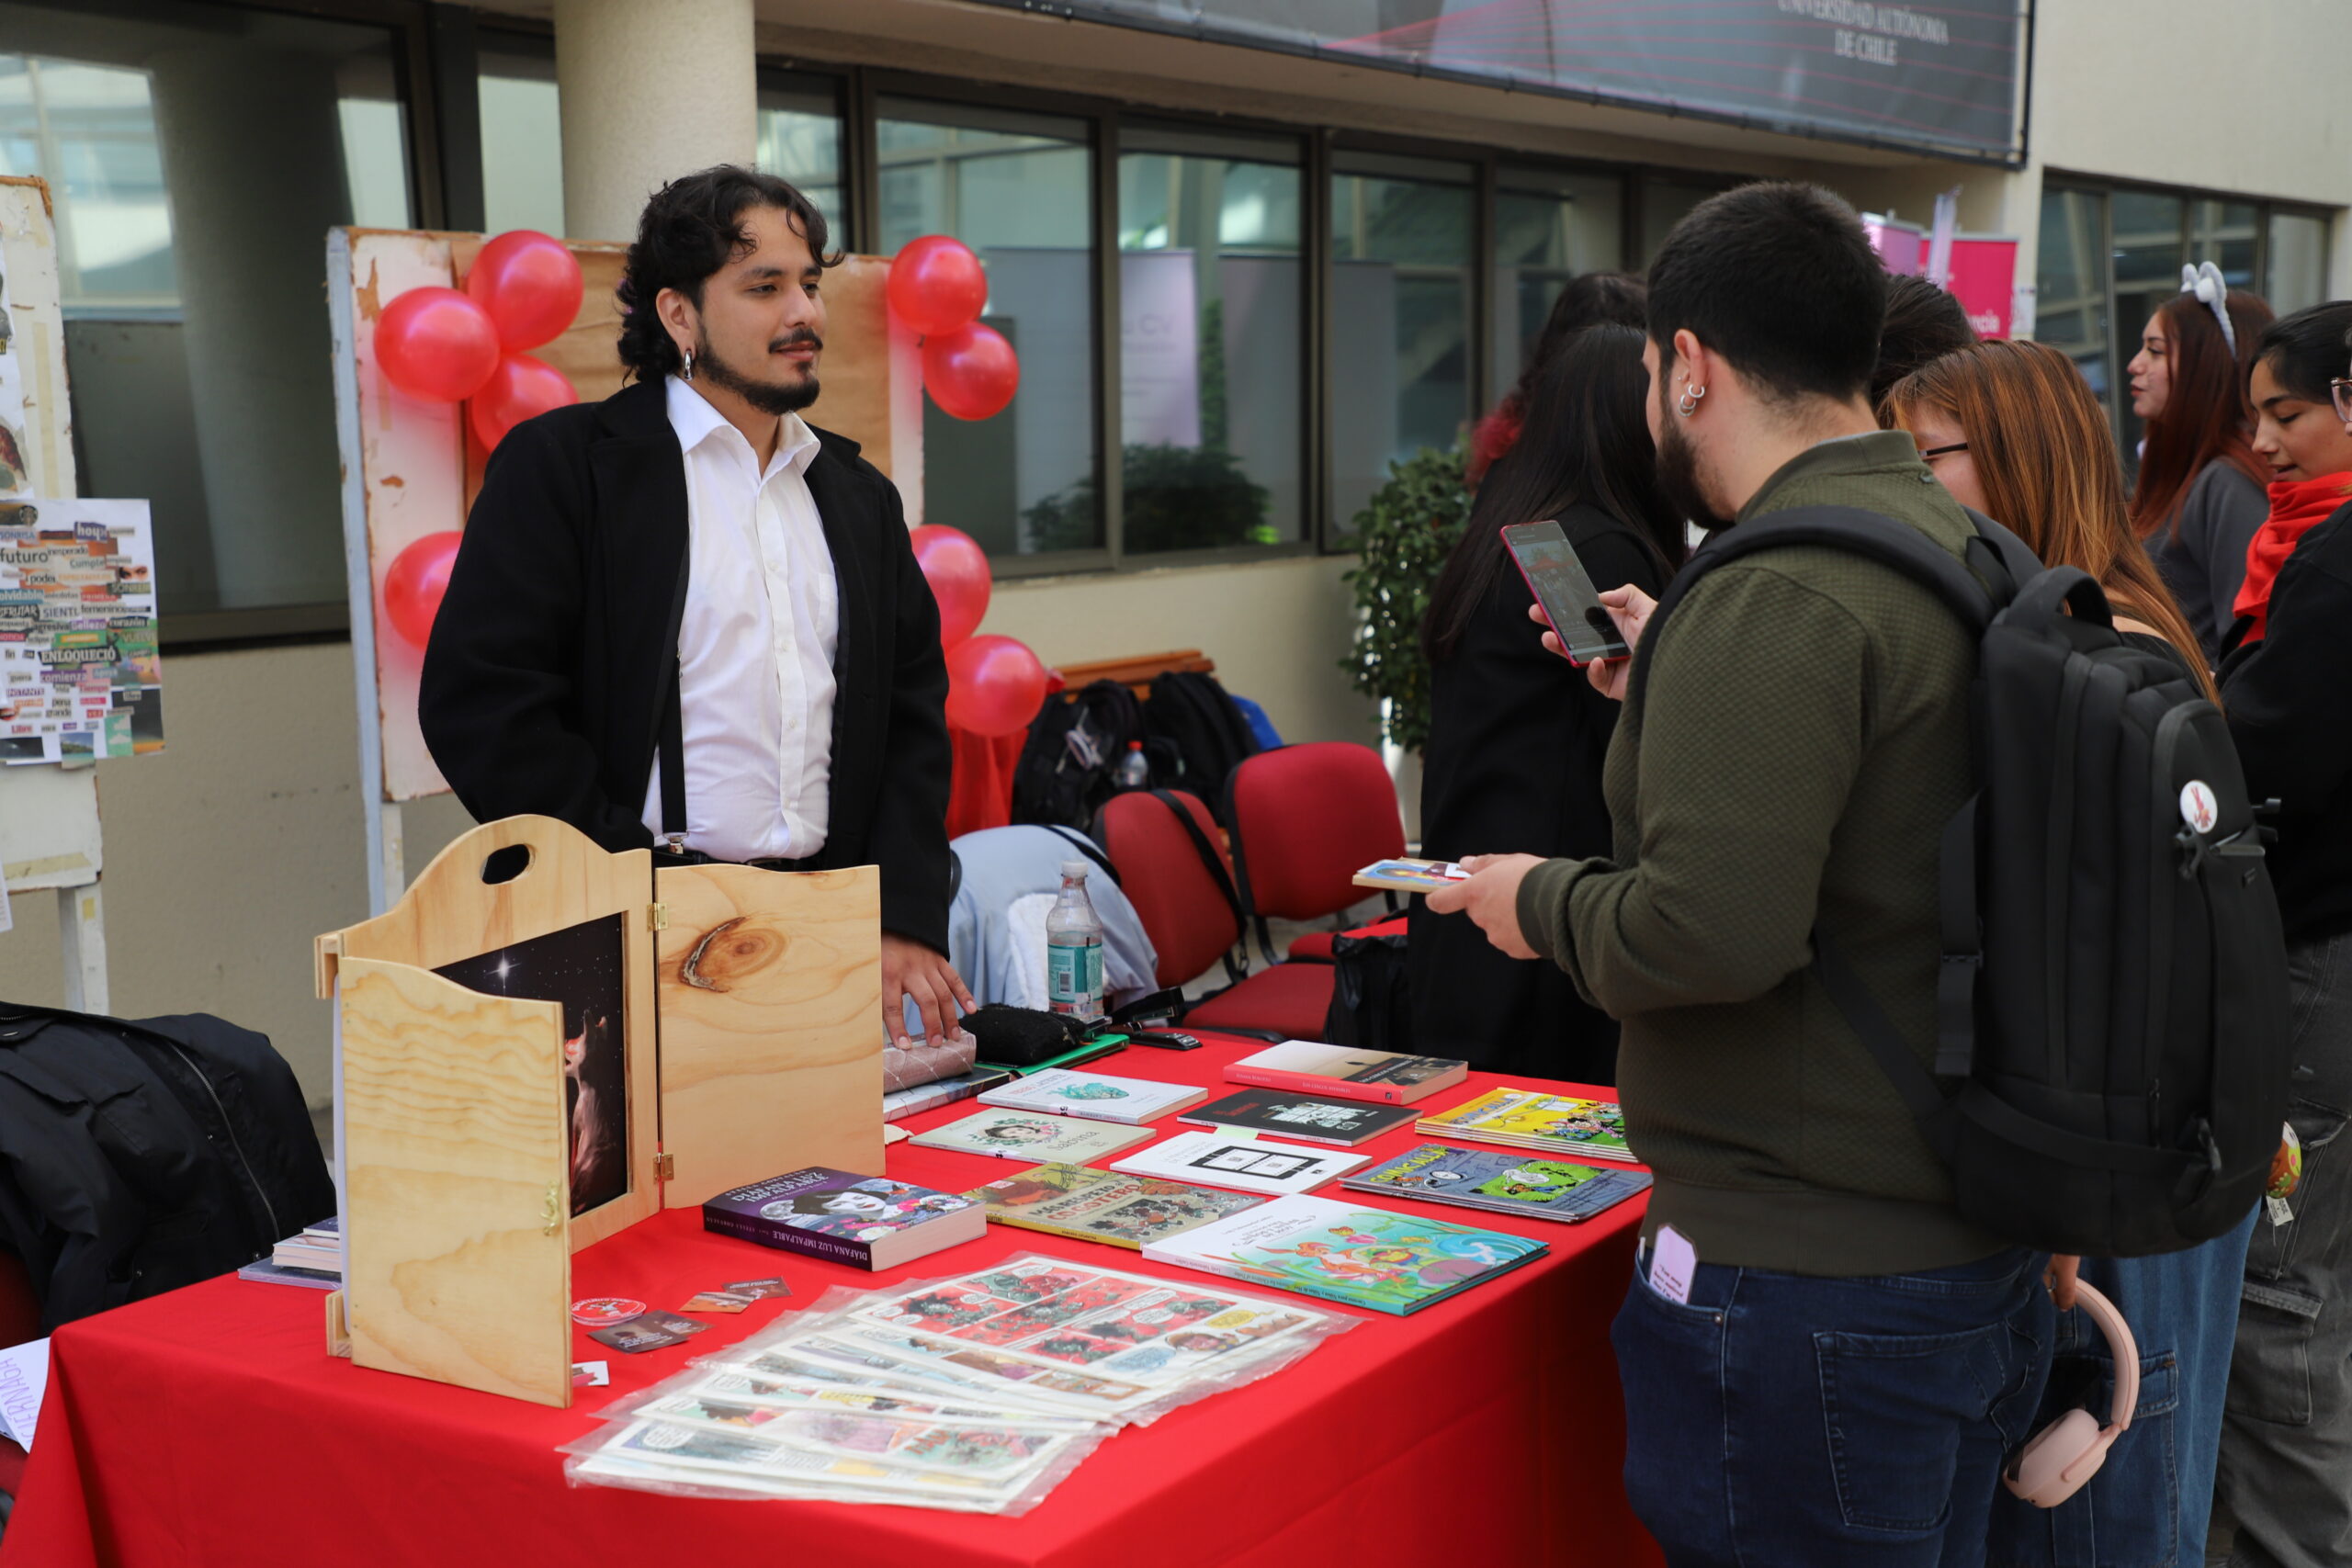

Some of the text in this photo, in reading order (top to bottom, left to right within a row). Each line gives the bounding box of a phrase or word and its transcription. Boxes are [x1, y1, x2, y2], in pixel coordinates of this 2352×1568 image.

[1835, 28, 1898, 66] DE CHILE
[41, 646, 116, 661] ENLOQUECIÓ
[1046, 1183, 1141, 1221] COGOTERO
[773, 1230, 868, 1261] DIÁFANA LUZ IMPALPABLE
